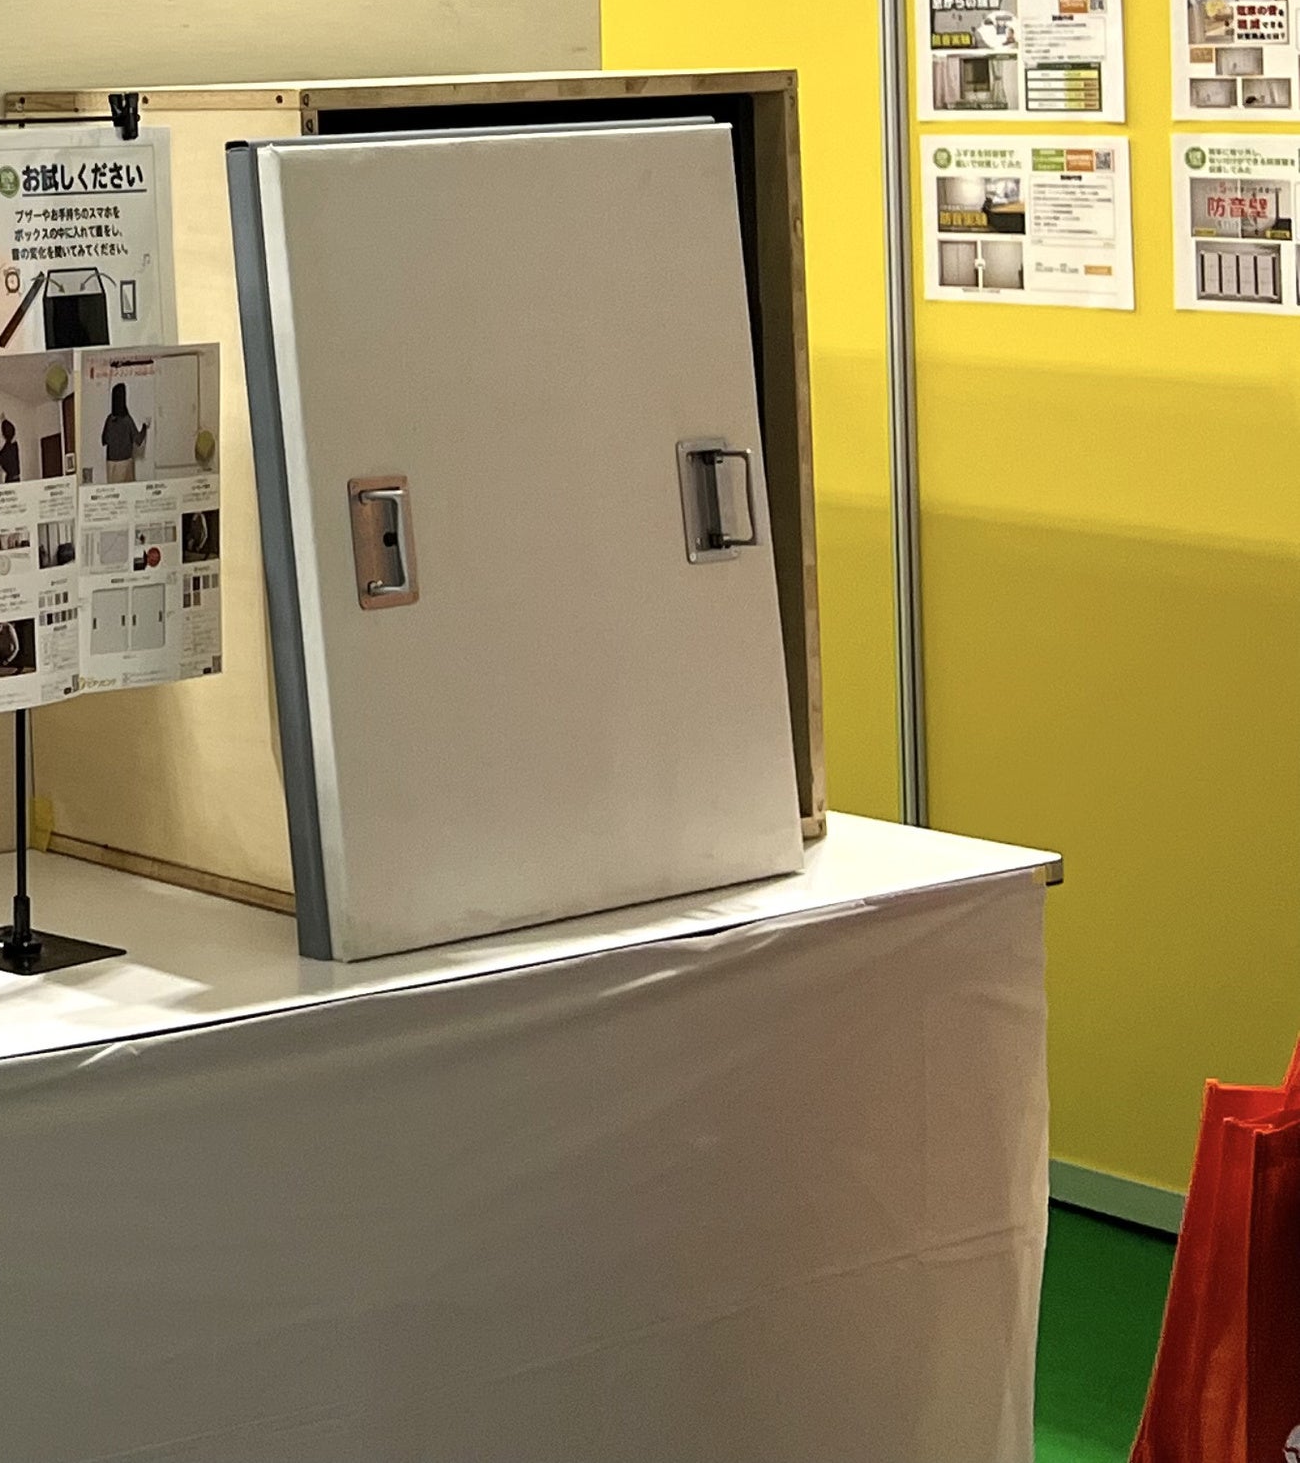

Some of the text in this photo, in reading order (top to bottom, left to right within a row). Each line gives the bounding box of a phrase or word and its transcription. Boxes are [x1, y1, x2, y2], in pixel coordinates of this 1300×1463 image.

[21, 162, 144, 192] お試しください
